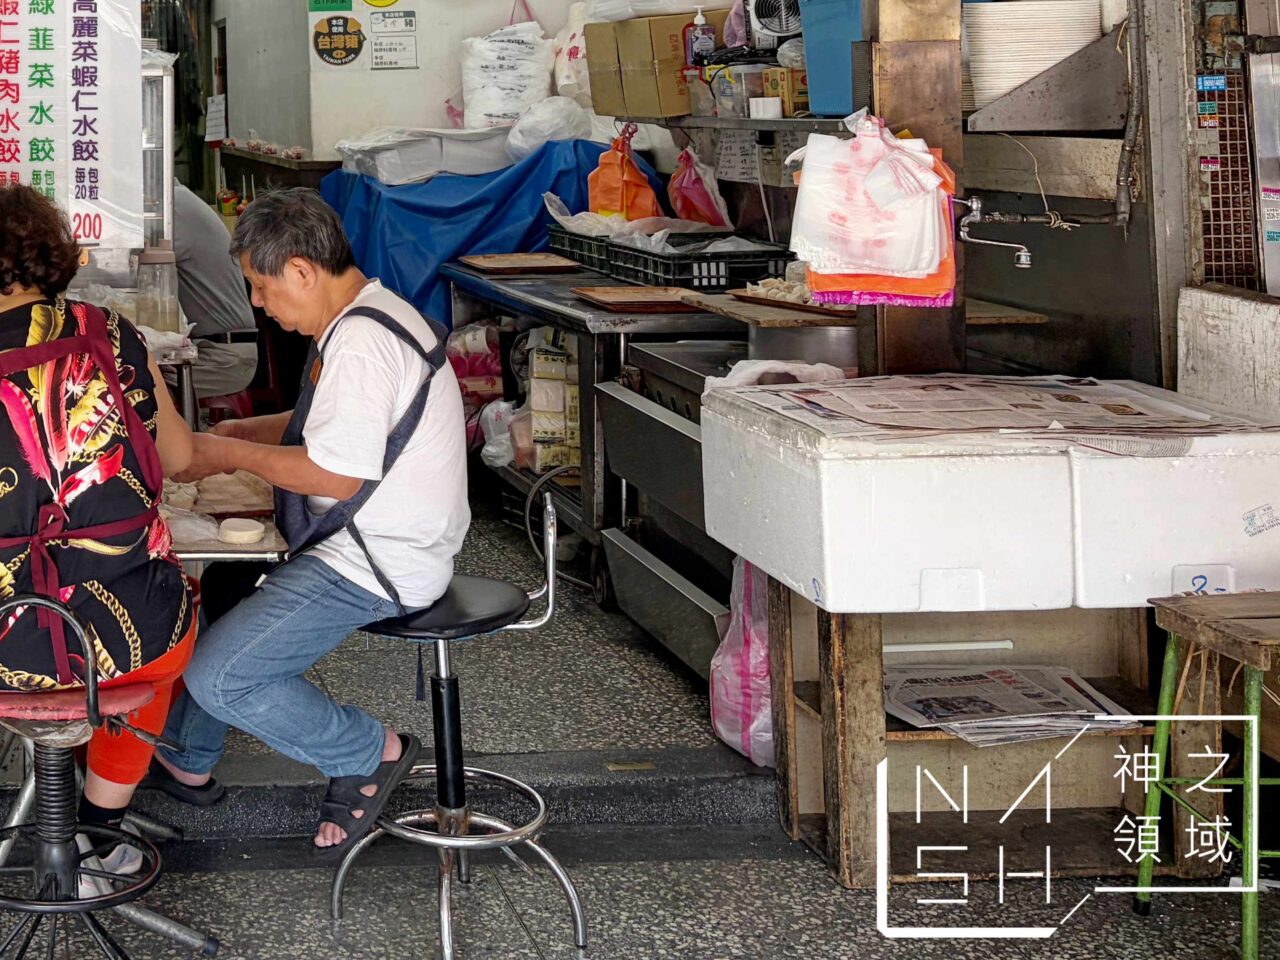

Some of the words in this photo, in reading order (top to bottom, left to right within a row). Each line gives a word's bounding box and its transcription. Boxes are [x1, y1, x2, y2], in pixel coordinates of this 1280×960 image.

[31, 169, 55, 185] 每包
[75, 167, 99, 183] 每包
[74, 184, 99, 201] 20粒
[73, 212, 103, 240] 200
